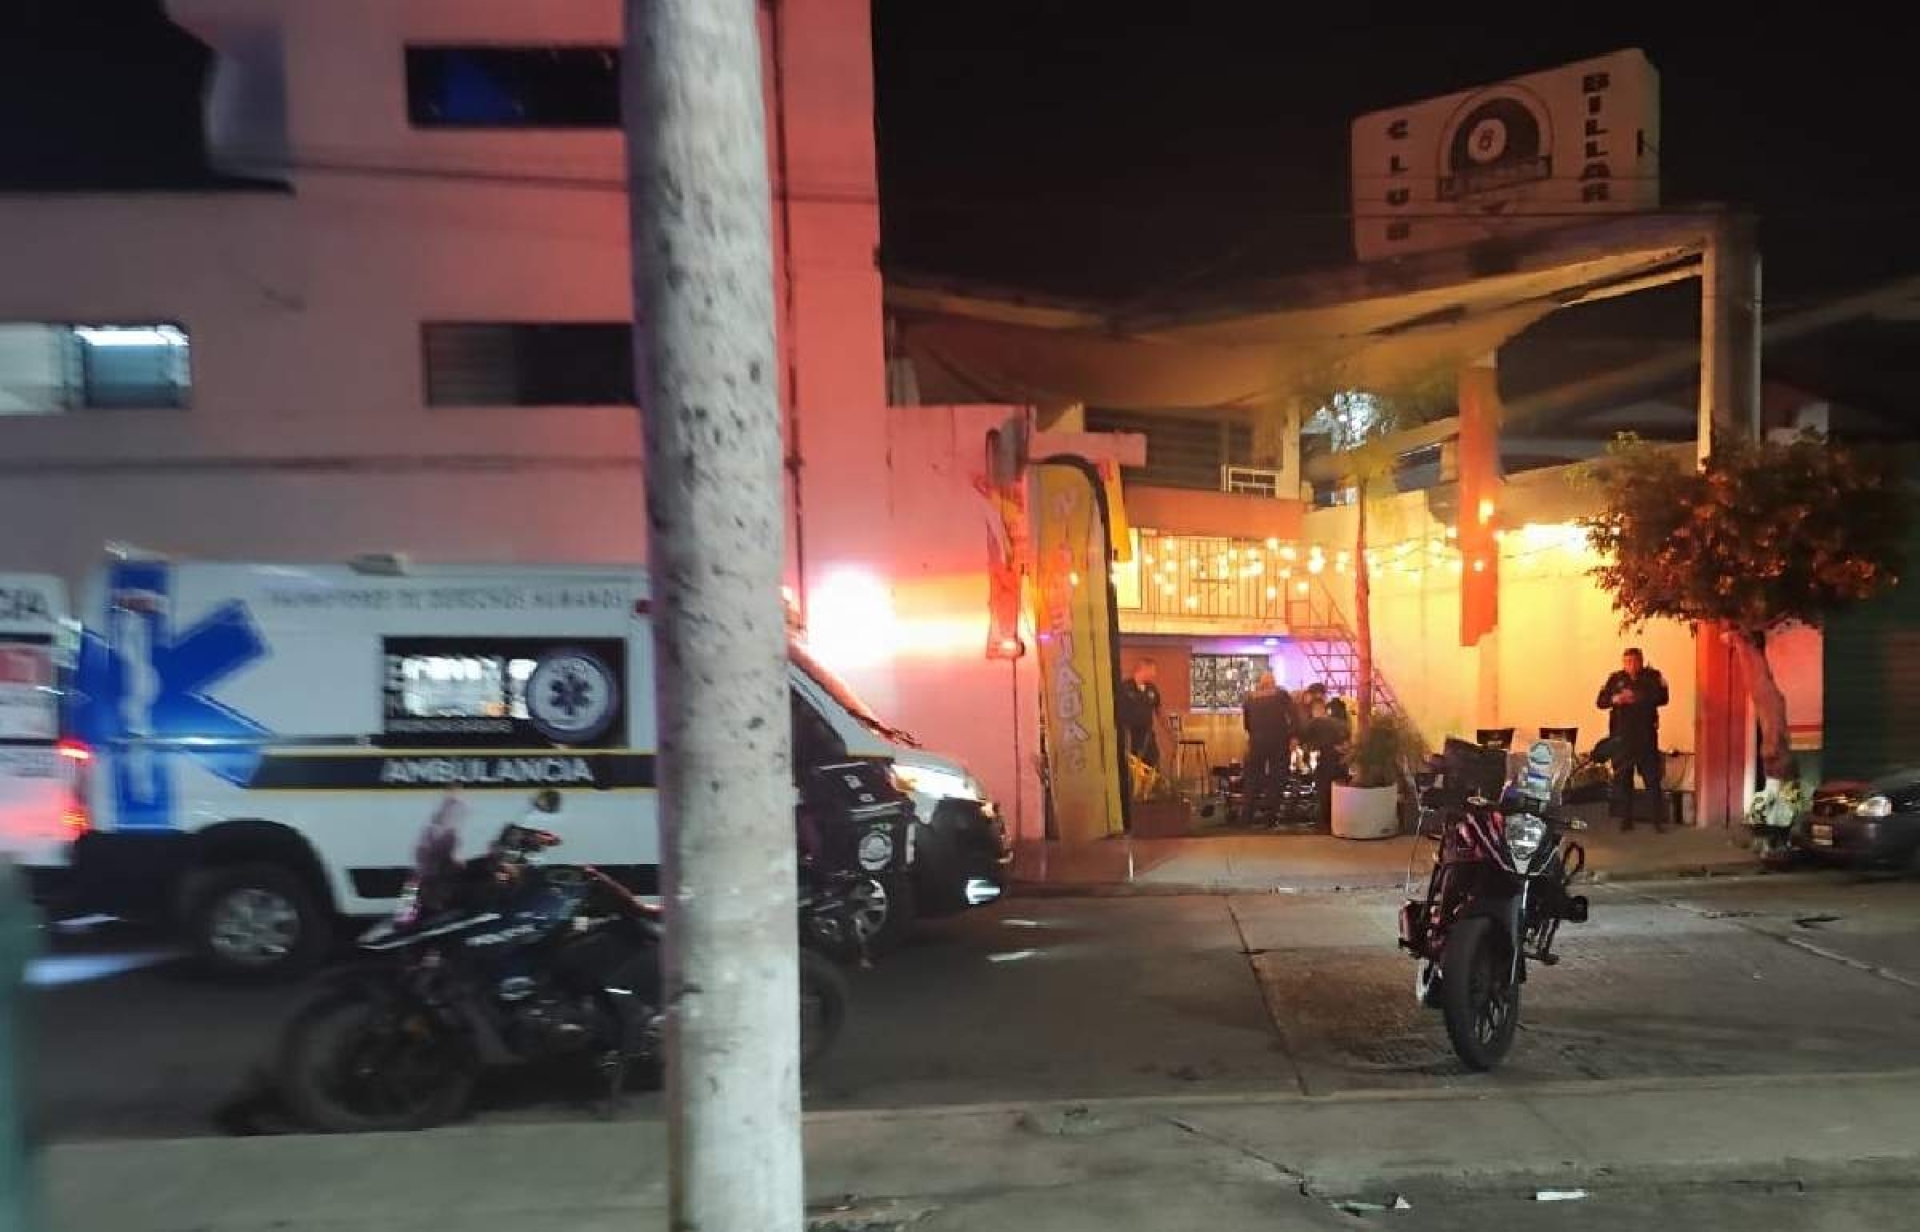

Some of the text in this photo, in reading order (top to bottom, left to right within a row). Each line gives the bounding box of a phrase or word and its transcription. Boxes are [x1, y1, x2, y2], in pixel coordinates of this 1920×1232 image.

[1385, 119, 1410, 241] CLUB
[1579, 72, 1611, 204] BILLAR
[385, 758, 595, 784] AMBULANCIA
